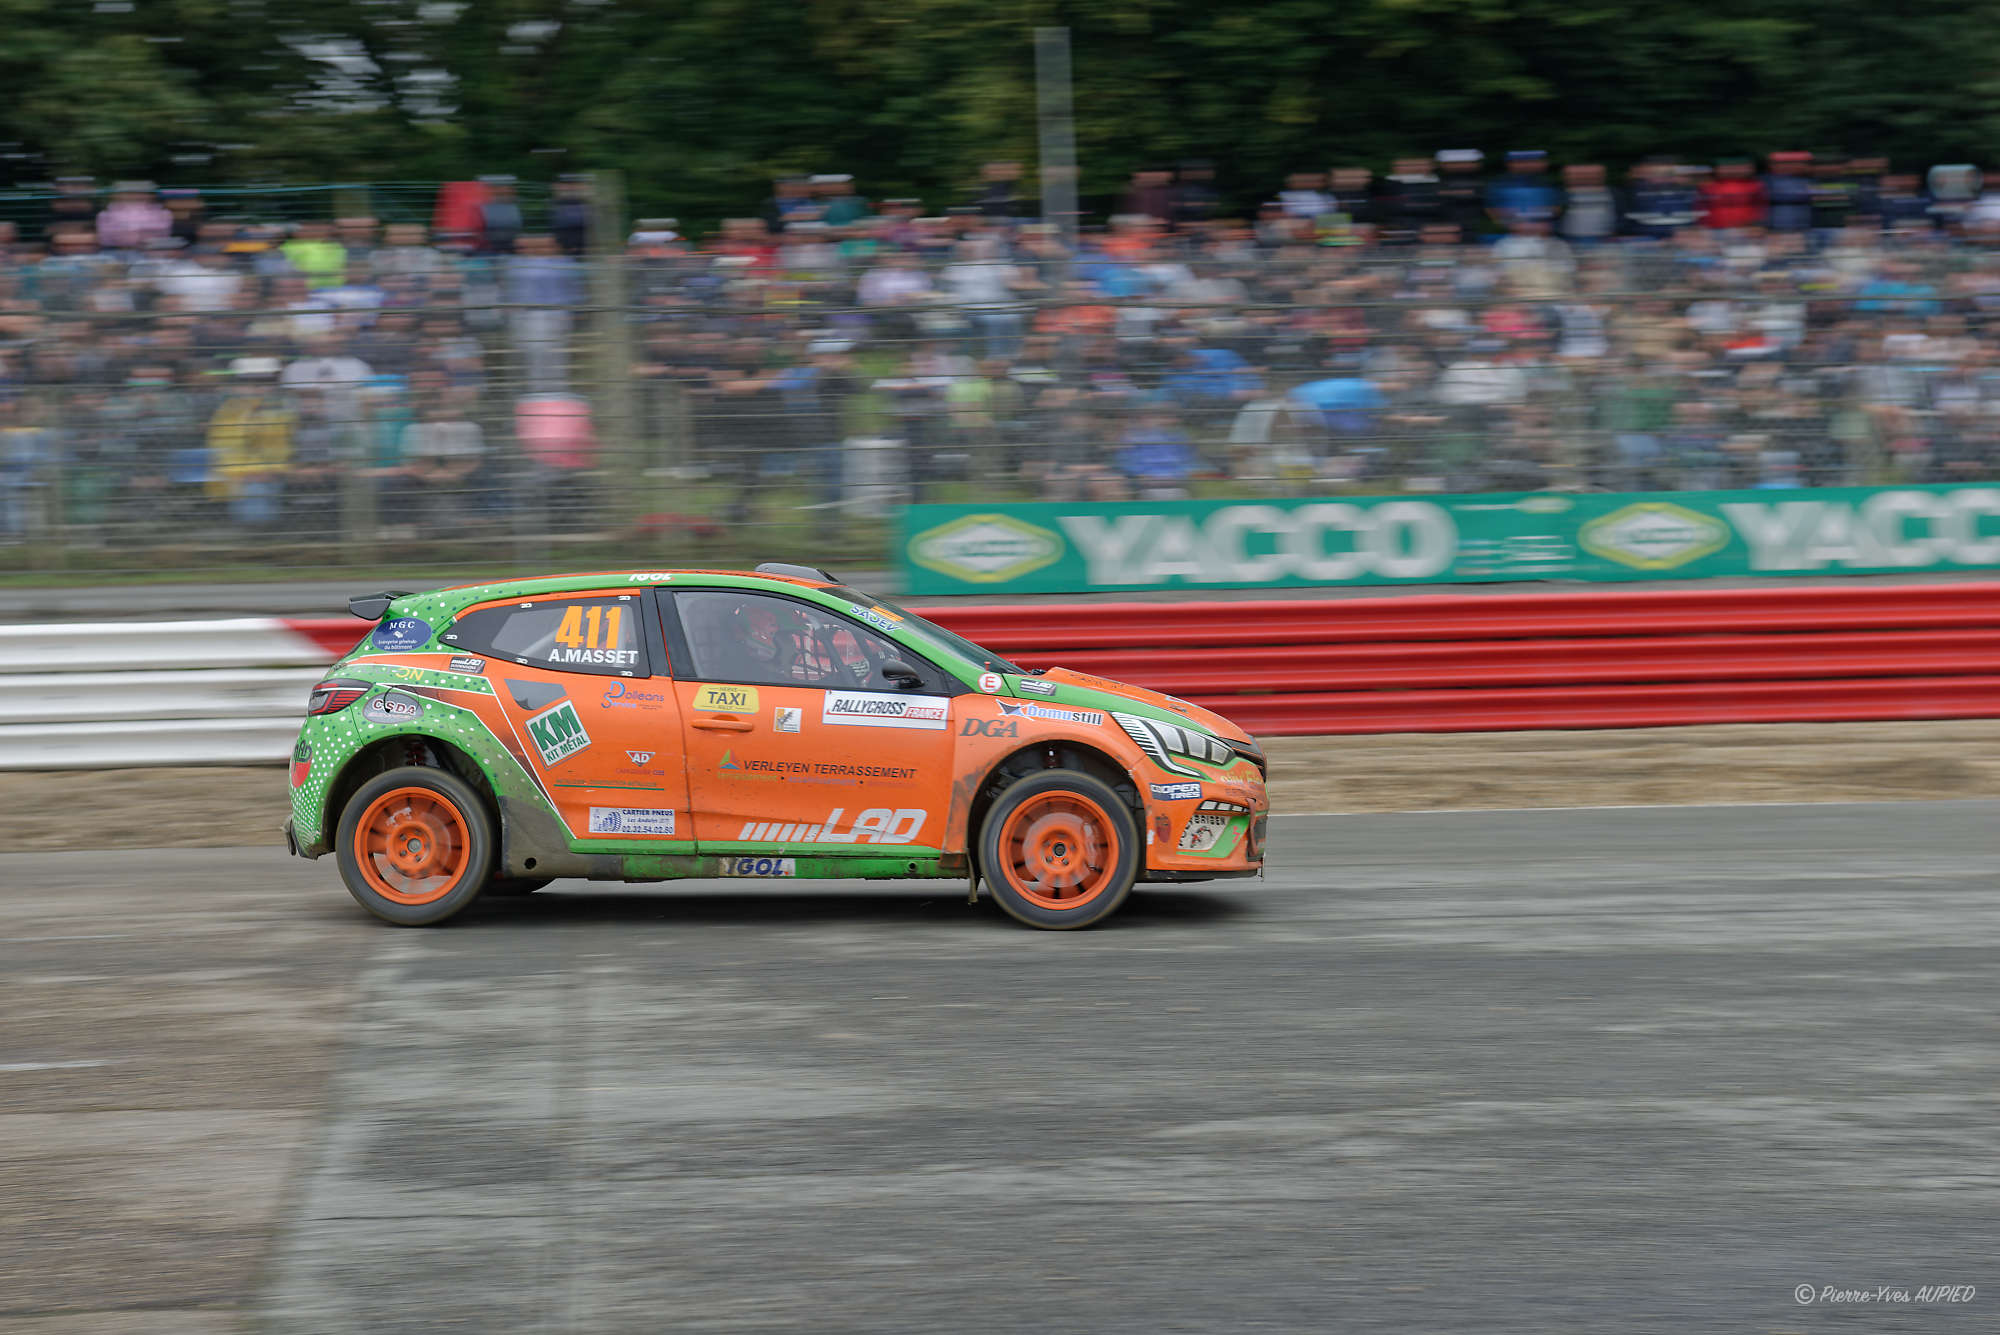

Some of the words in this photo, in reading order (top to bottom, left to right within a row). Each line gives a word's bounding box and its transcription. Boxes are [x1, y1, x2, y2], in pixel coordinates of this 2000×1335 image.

[1056, 501, 1458, 585] YACCO
[555, 605, 622, 649] 411
[548, 648, 638, 664] A.MASSET
[985, 676, 996, 688] E
[373, 700, 417, 715] CSDA
[708, 691, 747, 706] TAXI
[832, 699, 906, 715] RALLYCROSS
[907, 708, 944, 719] FRANCE
[1027, 705, 1103, 725] Domustill
[530, 705, 582, 751] KM
[960, 718, 1019, 738] DGA
[545, 749, 560, 762] KIT
[561, 735, 587, 755] MÉTAL
[632, 753, 650, 764] AD
[743, 760, 810, 773] VERLEYEN
[814, 763, 917, 779] TERRASSEMENT
[816, 808, 927, 843] LAD
